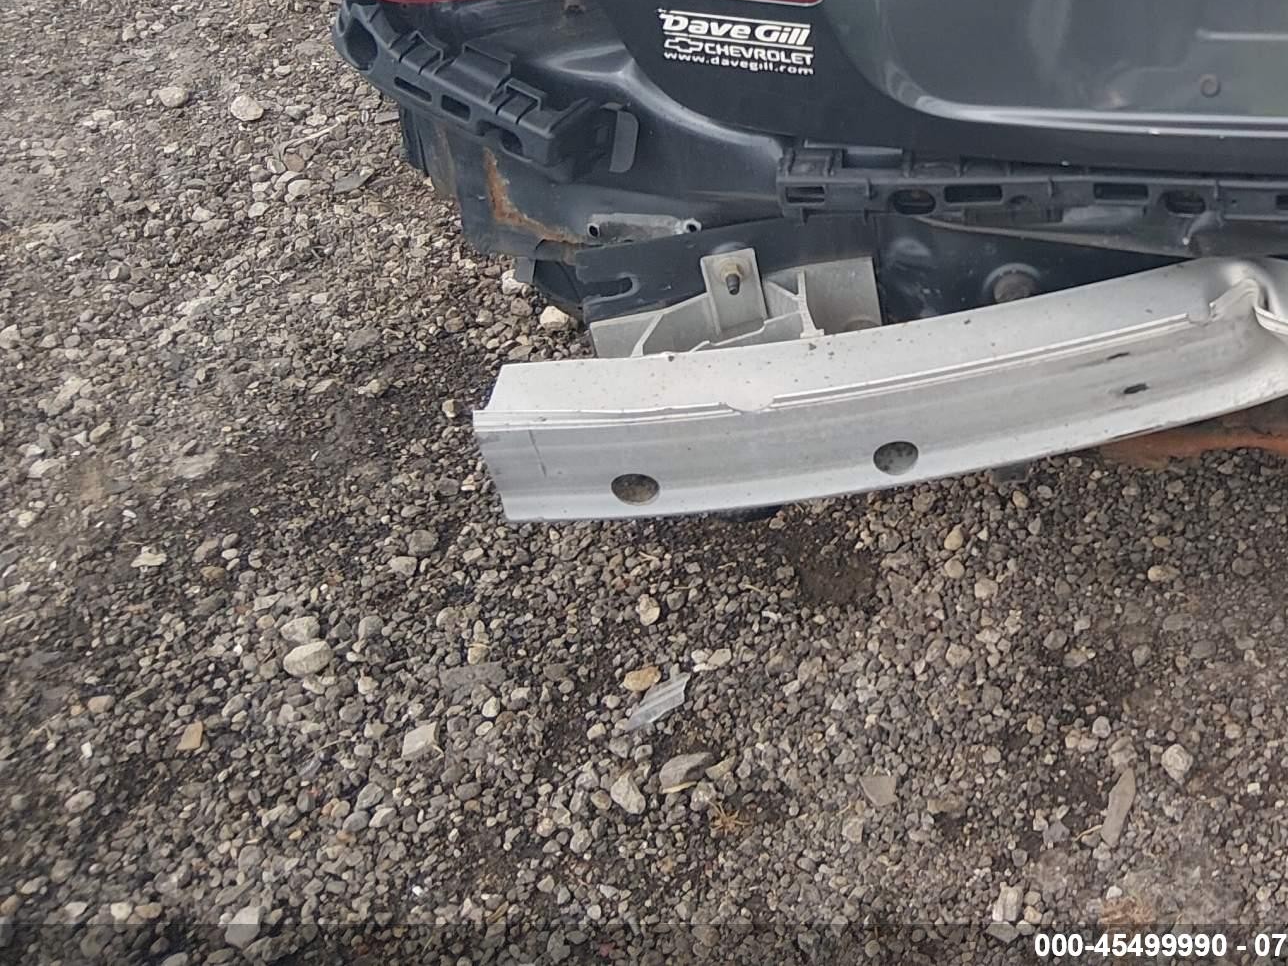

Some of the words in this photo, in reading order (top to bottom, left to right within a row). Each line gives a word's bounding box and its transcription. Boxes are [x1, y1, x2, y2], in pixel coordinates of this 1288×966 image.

[659, 13, 751, 39] Dave
[754, 24, 810, 46] Gill
[704, 42, 814, 65] CHEVROLET
